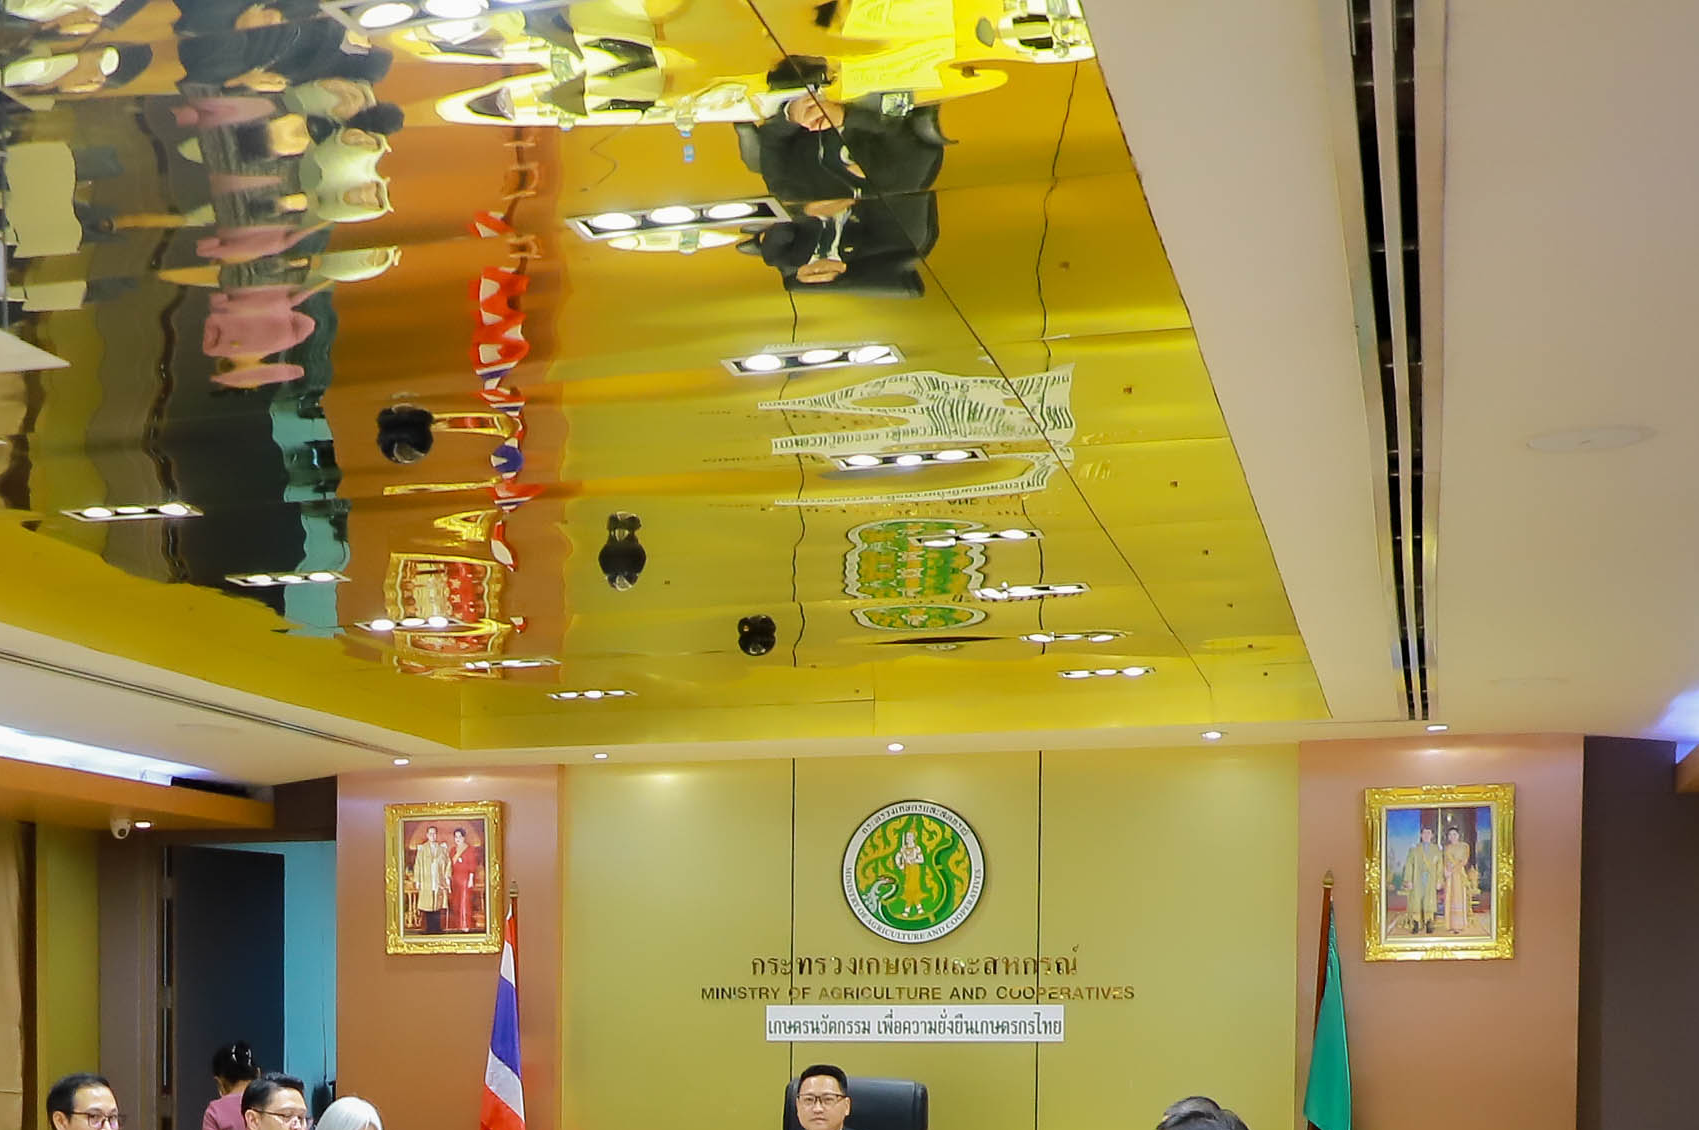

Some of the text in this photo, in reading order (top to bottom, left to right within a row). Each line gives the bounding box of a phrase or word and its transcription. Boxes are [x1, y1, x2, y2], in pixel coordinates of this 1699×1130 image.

[867, 918, 926, 941] AGRICULTURE
[927, 924, 945, 938] AND
[945, 868, 982, 929] COOPERATIVES
[751, 944, 1079, 976] กระทรวงเกษตรและสหกรณ์
[701, 986, 1136, 1001] MINISTRY OF AGRICULTURE AND COOPERATIVES
[768, 1008, 1063, 1036] เกษตรนวัตกรรม เพื่อความยั่งยืนเกษตรกรไทย
